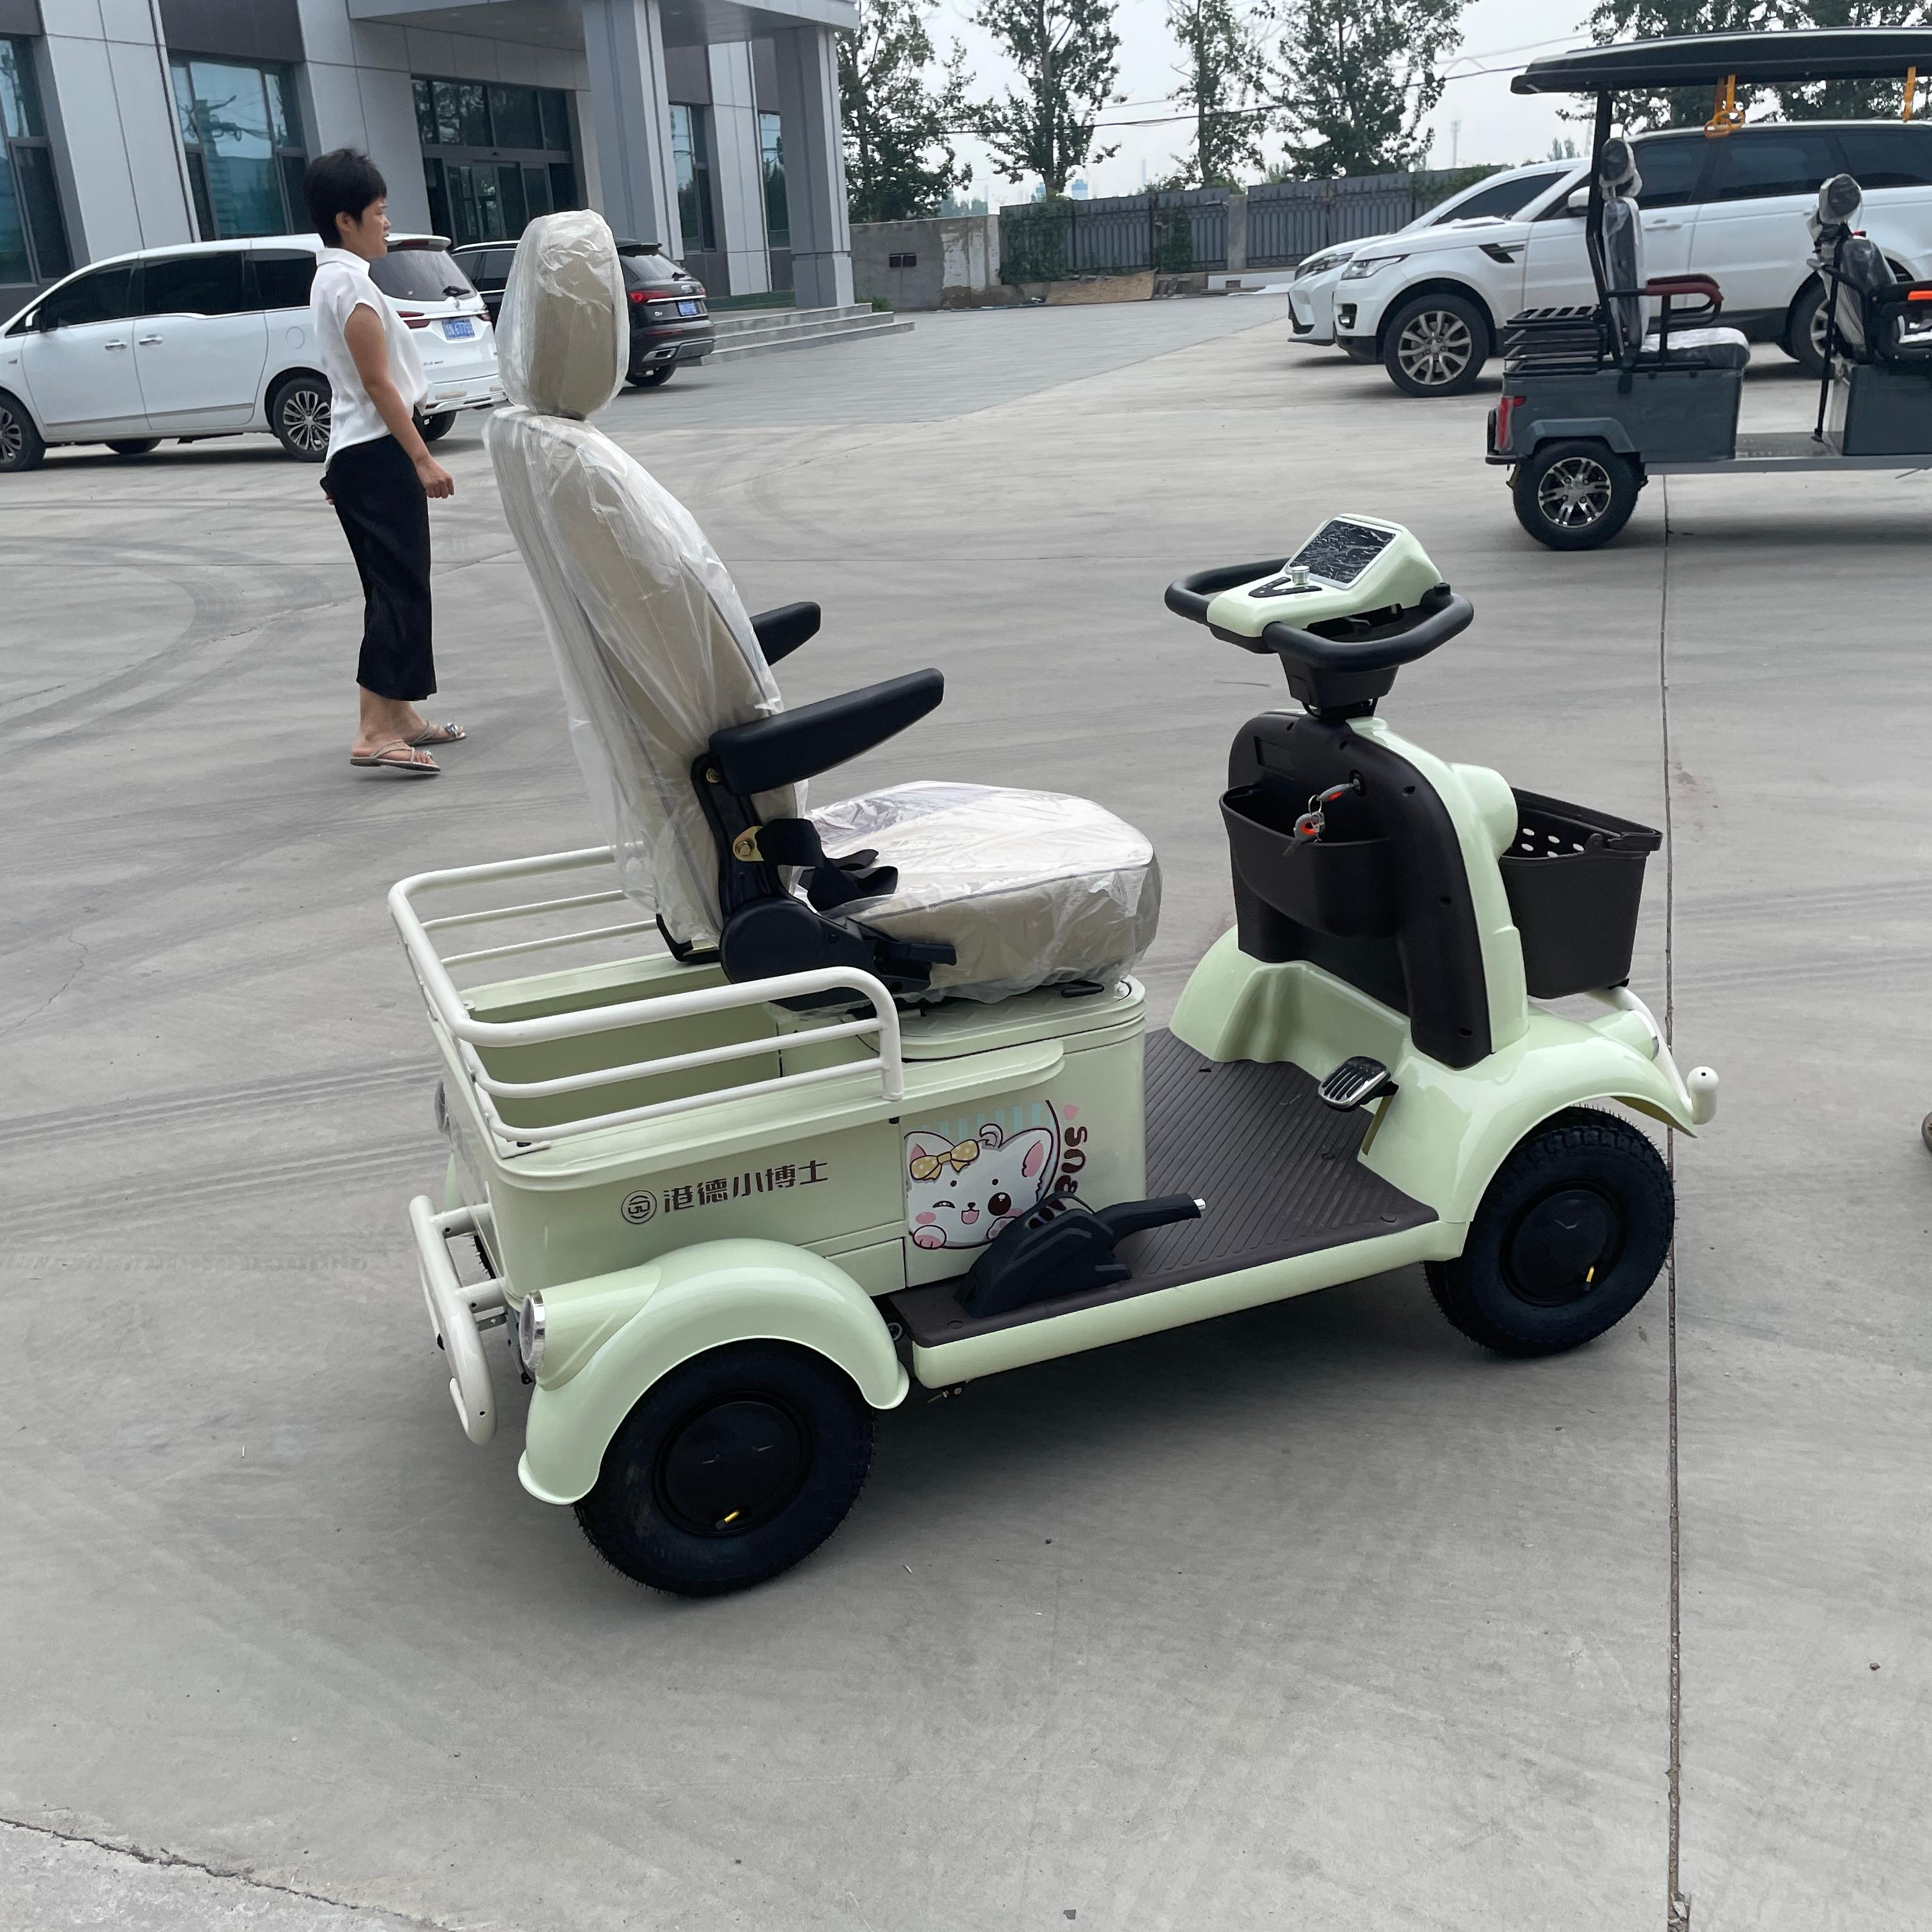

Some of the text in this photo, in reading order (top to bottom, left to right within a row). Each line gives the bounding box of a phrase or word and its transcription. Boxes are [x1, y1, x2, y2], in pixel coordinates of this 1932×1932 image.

[663, 1160, 828, 1213] 港德小博士
